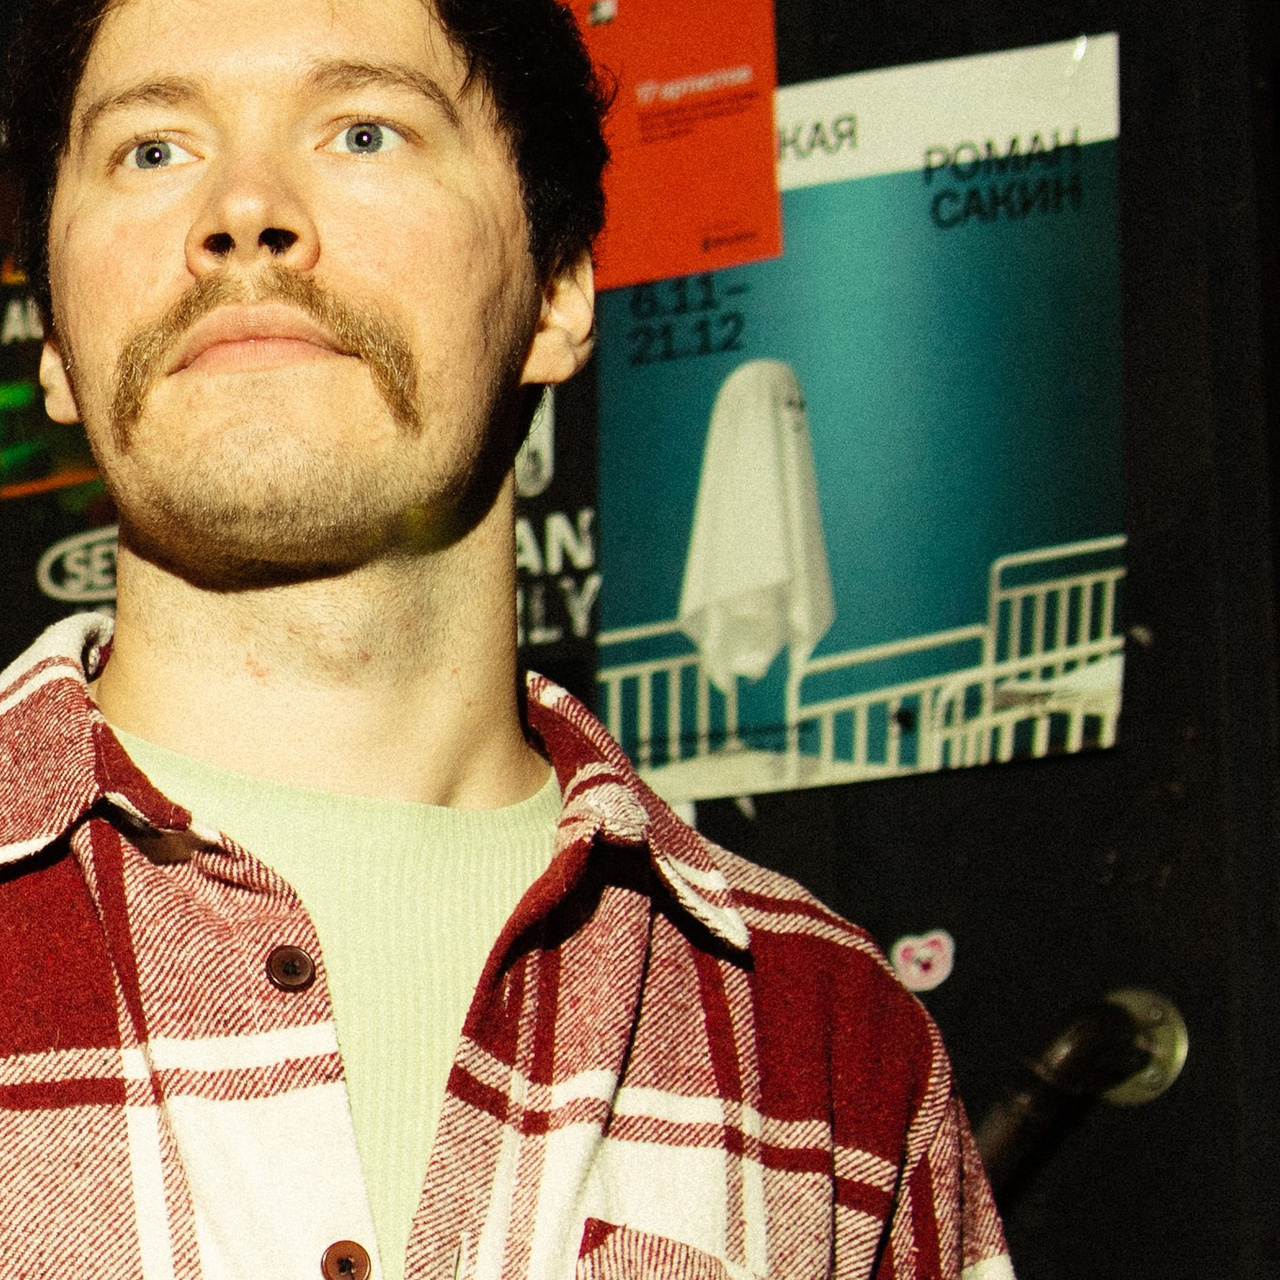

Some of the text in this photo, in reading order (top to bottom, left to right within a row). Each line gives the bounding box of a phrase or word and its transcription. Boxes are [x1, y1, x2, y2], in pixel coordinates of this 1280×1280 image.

[923, 125, 1081, 186] РОМАН
[930, 174, 1083, 231] САКИН
[627, 311, 745, 367] 21.12
